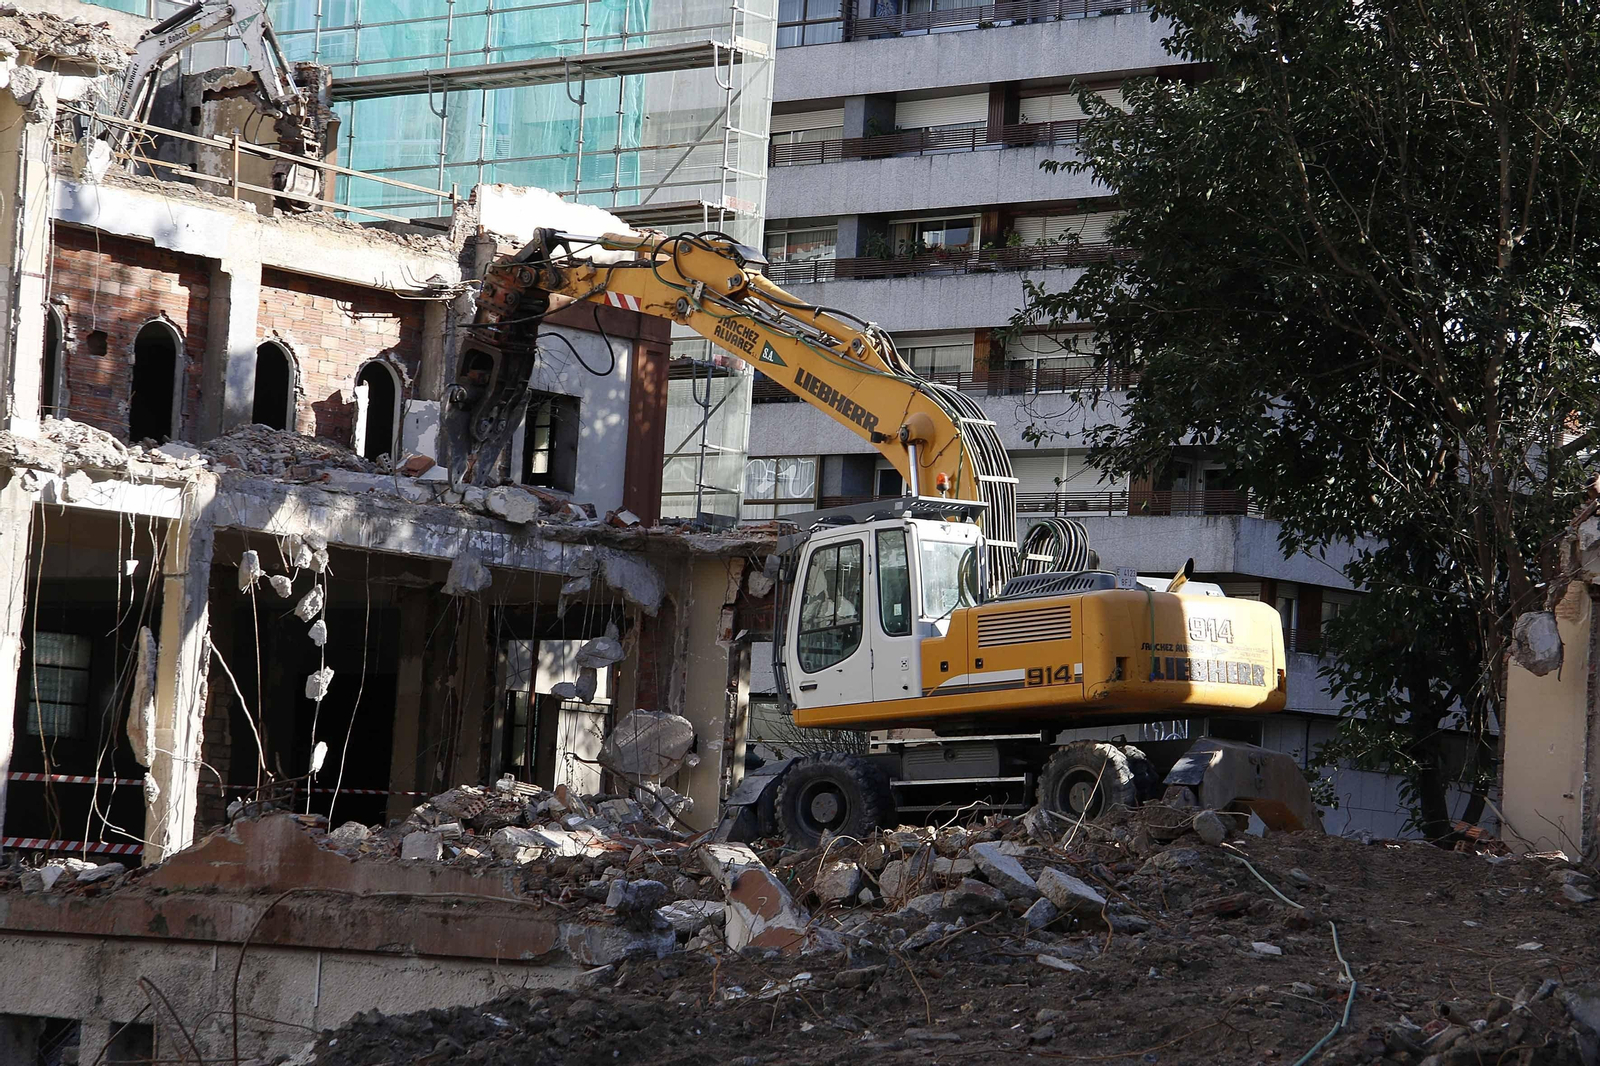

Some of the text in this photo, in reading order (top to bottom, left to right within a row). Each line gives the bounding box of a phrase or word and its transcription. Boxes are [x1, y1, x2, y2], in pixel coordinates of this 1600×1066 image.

[167, 28, 189, 43] Bobcat
[714, 325, 754, 355] ALVAREZ
[762, 347, 774, 362] S.A.
[794, 367, 879, 433] LIEBHERR
[1189, 617, 1234, 643] 914
[1141, 642, 1174, 652] SACHEZ
[1027, 664, 1072, 686] 914
[1152, 657, 1266, 687] LIEBHERR
